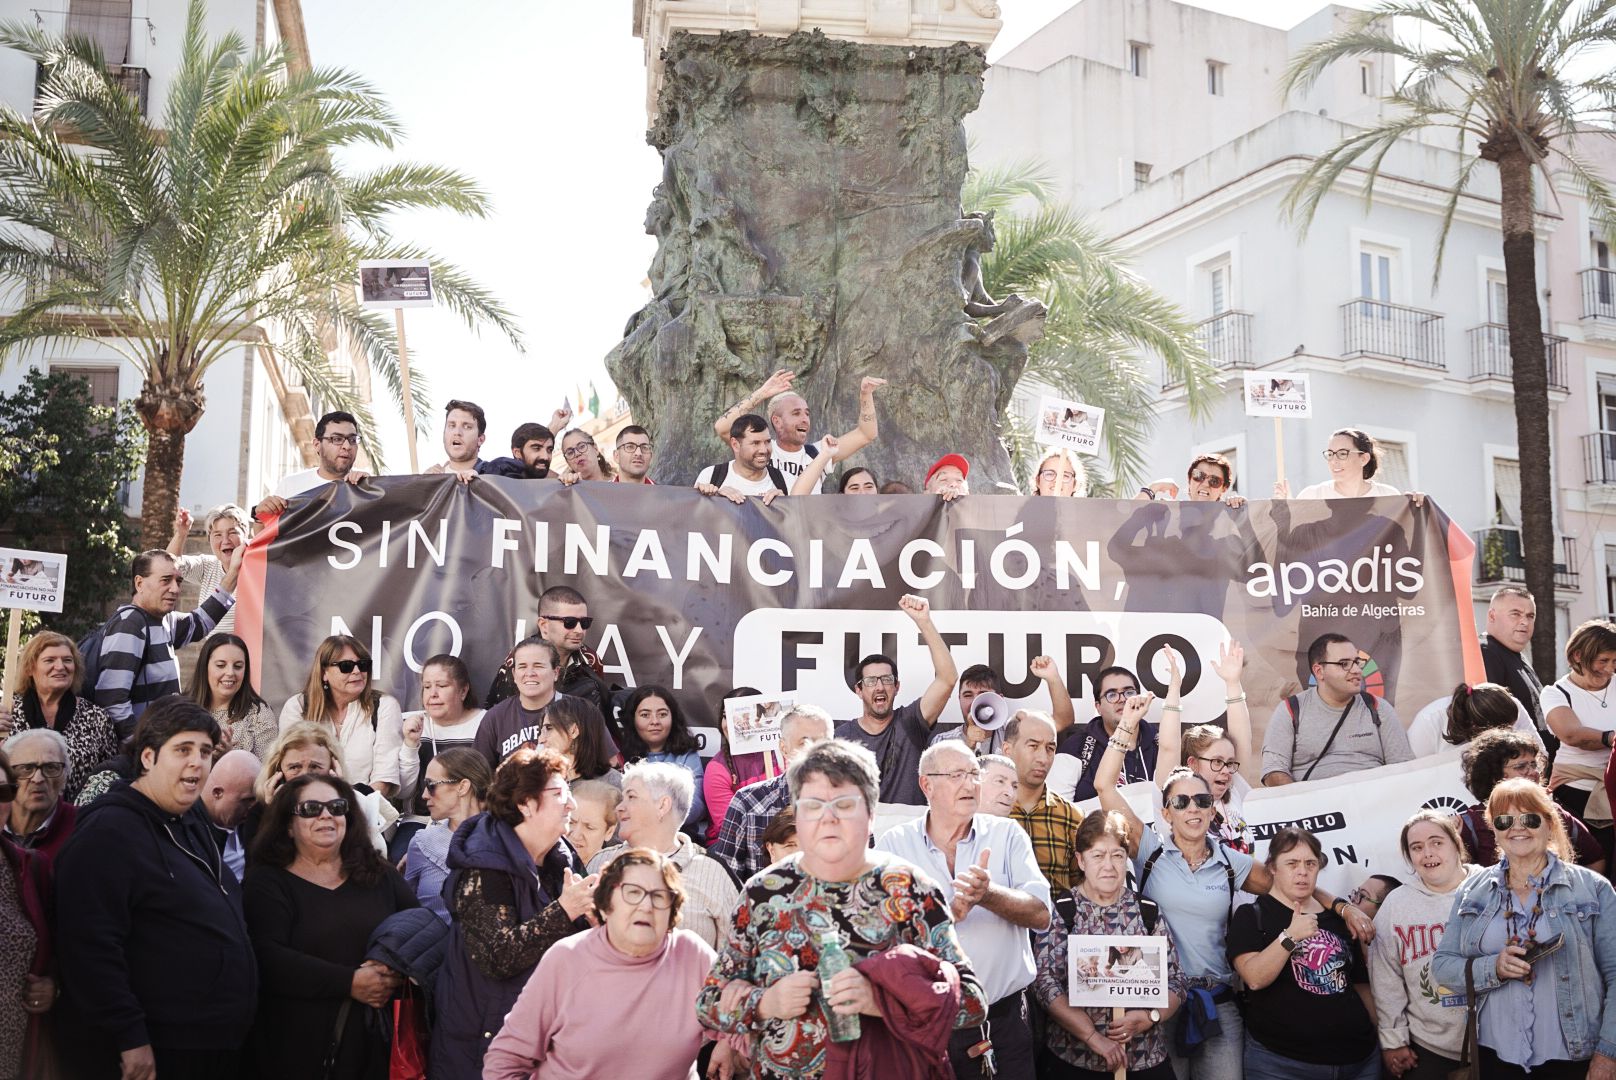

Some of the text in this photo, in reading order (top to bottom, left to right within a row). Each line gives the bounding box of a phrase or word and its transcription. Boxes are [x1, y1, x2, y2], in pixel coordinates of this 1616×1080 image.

[1272, 403, 1307, 411] FUTURO
[1061, 434, 1095, 447] FUTURO
[327, 517, 1126, 601] SIN FINANCIACIÓN,
[1246, 543, 1425, 605] apadis
[10, 591, 56, 601] FUTURO
[1302, 602, 1425, 619] Bahía de Algeciras
[515, 618, 704, 693] AY
[1109, 986, 1160, 995] FUTURO
